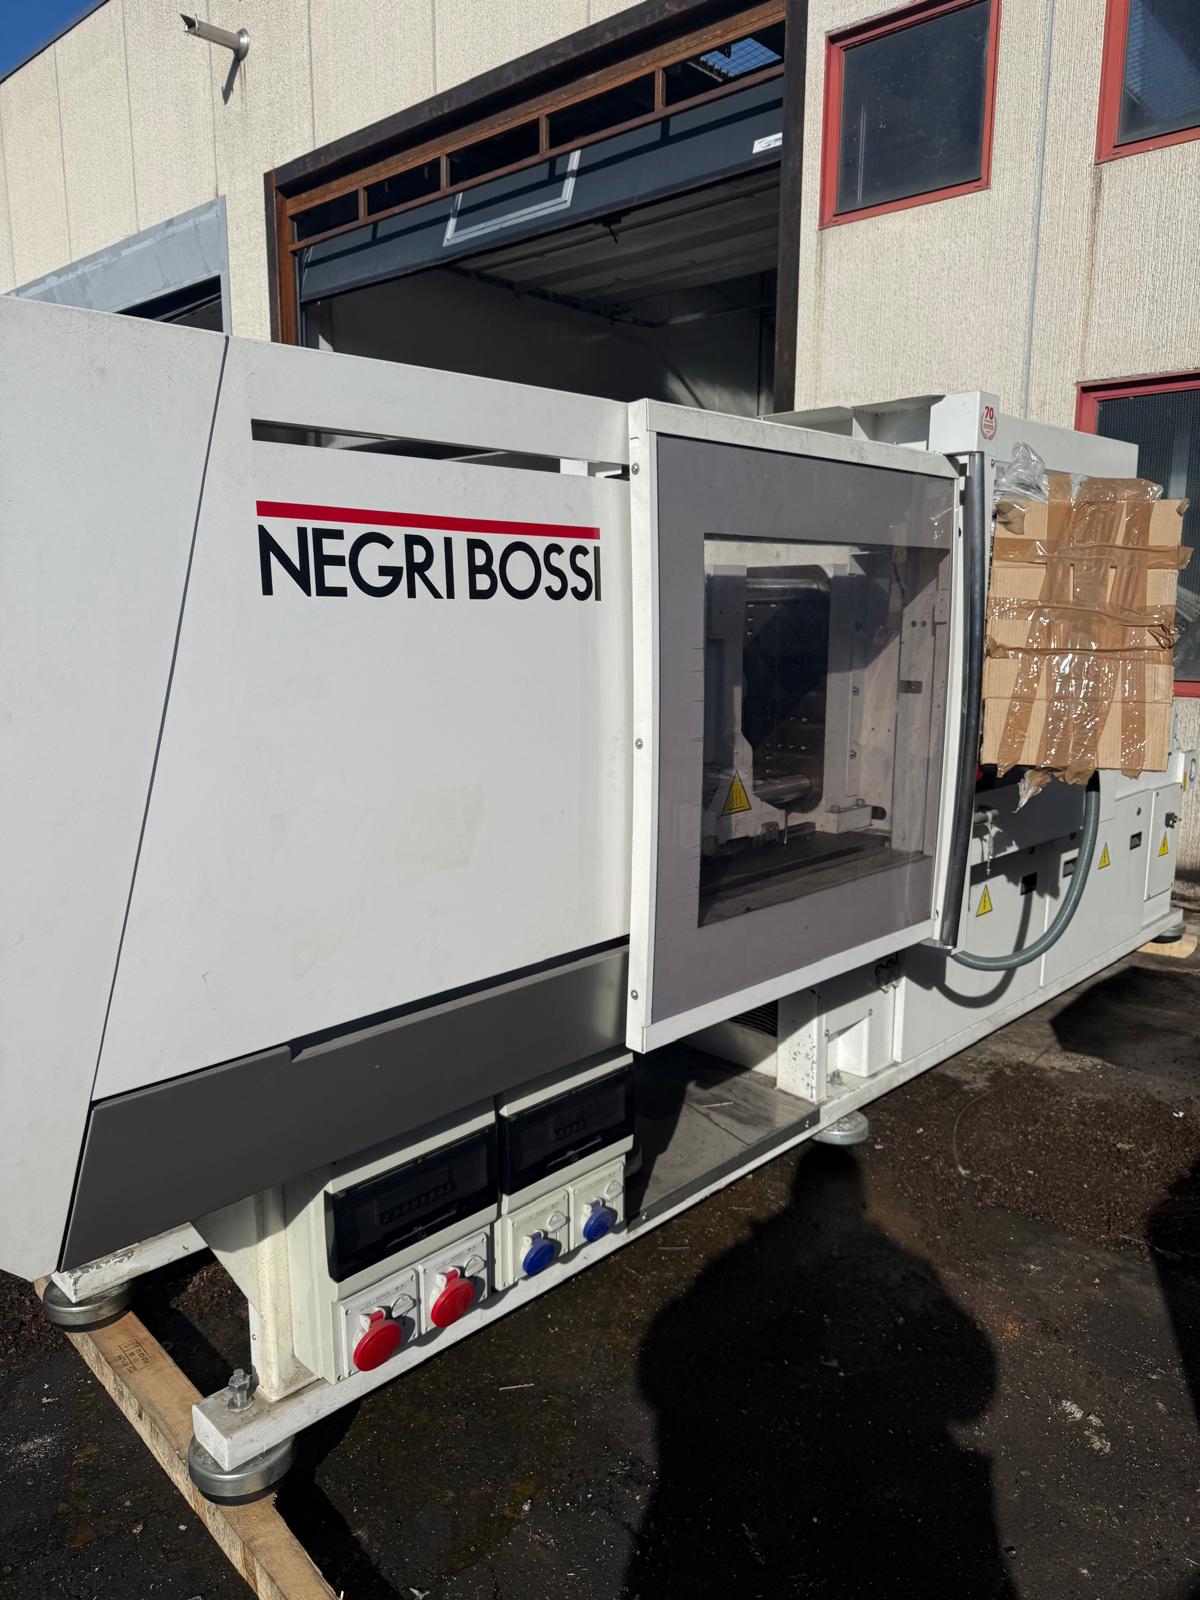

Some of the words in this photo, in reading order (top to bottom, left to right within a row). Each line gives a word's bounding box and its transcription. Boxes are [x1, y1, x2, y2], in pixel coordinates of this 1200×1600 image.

[985, 405, 994, 420] 70
[258, 524, 455, 599] NEGRI
[466, 537, 602, 602] BOSSI
